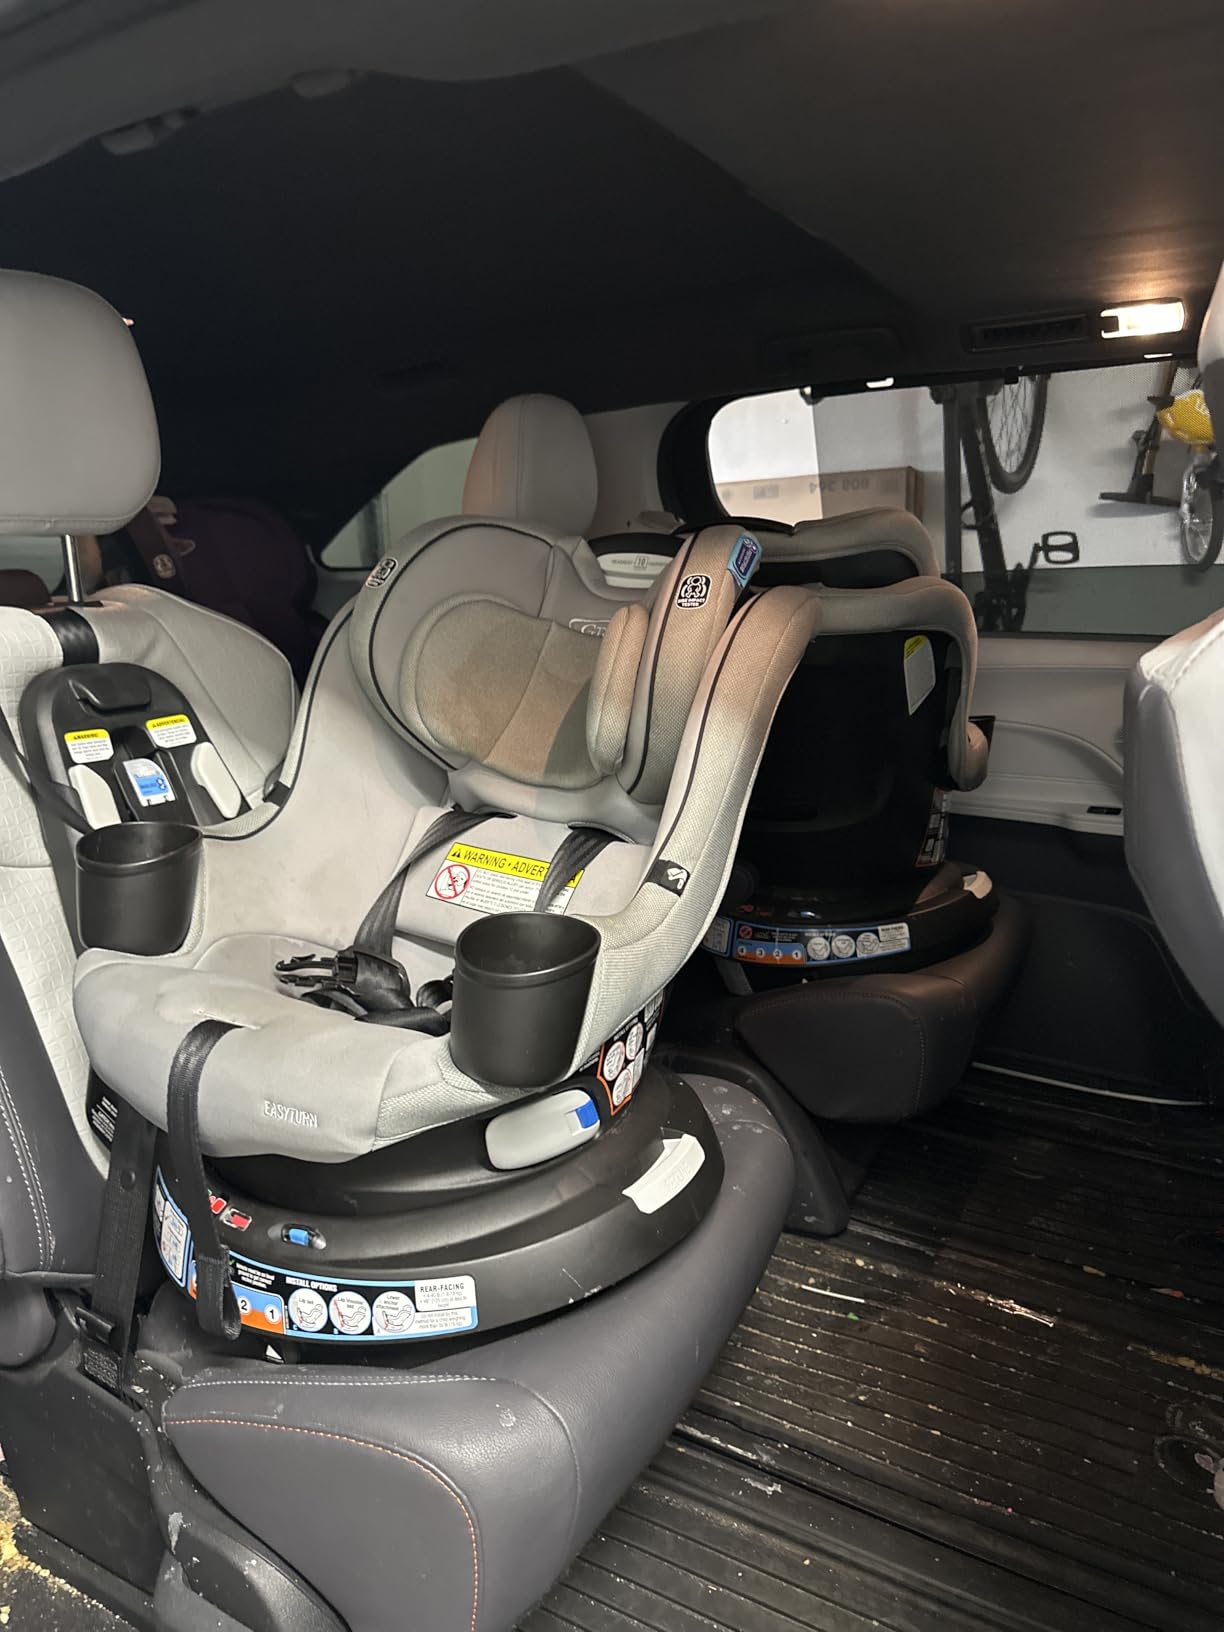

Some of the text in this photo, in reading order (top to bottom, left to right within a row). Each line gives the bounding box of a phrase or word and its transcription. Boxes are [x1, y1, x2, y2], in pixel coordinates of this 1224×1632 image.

[463, 849, 507, 869] WARNING
[264, 1100, 318, 1128] EASYTURN
[420, 1282, 465, 1293] REAR-FACING
[240, 1299, 248, 1311] 2
[269, 1308, 275, 1320] 1
